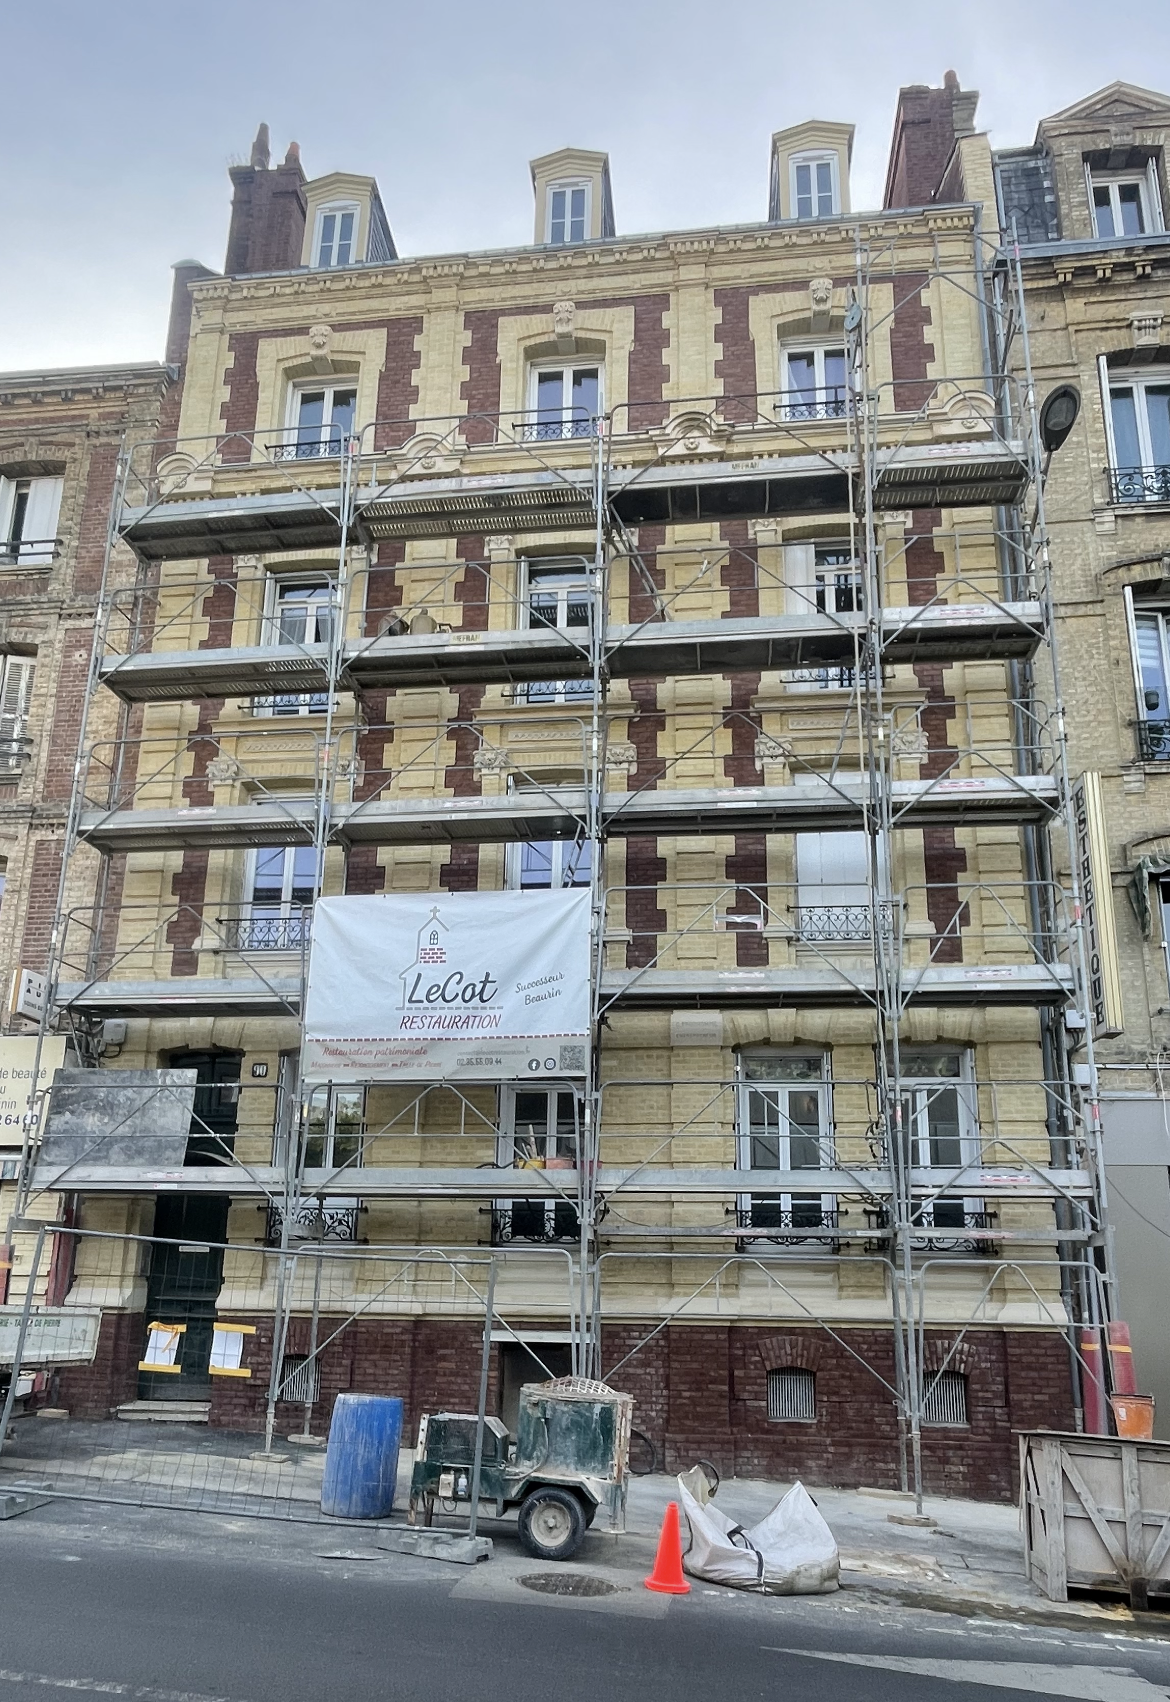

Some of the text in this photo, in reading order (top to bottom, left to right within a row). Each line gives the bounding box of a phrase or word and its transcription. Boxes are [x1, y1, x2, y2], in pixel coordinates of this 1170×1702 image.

[1075, 786, 1105, 1026] ESTHETIQUE
[407, 971, 498, 1004] LeCot
[515, 972, 565, 993] Successeur
[524, 988, 563, 1006] Beaurin
[400, 1014, 502, 1030] RESTAURATION
[322, 1046, 428, 1059] Restauration patrimoniale
